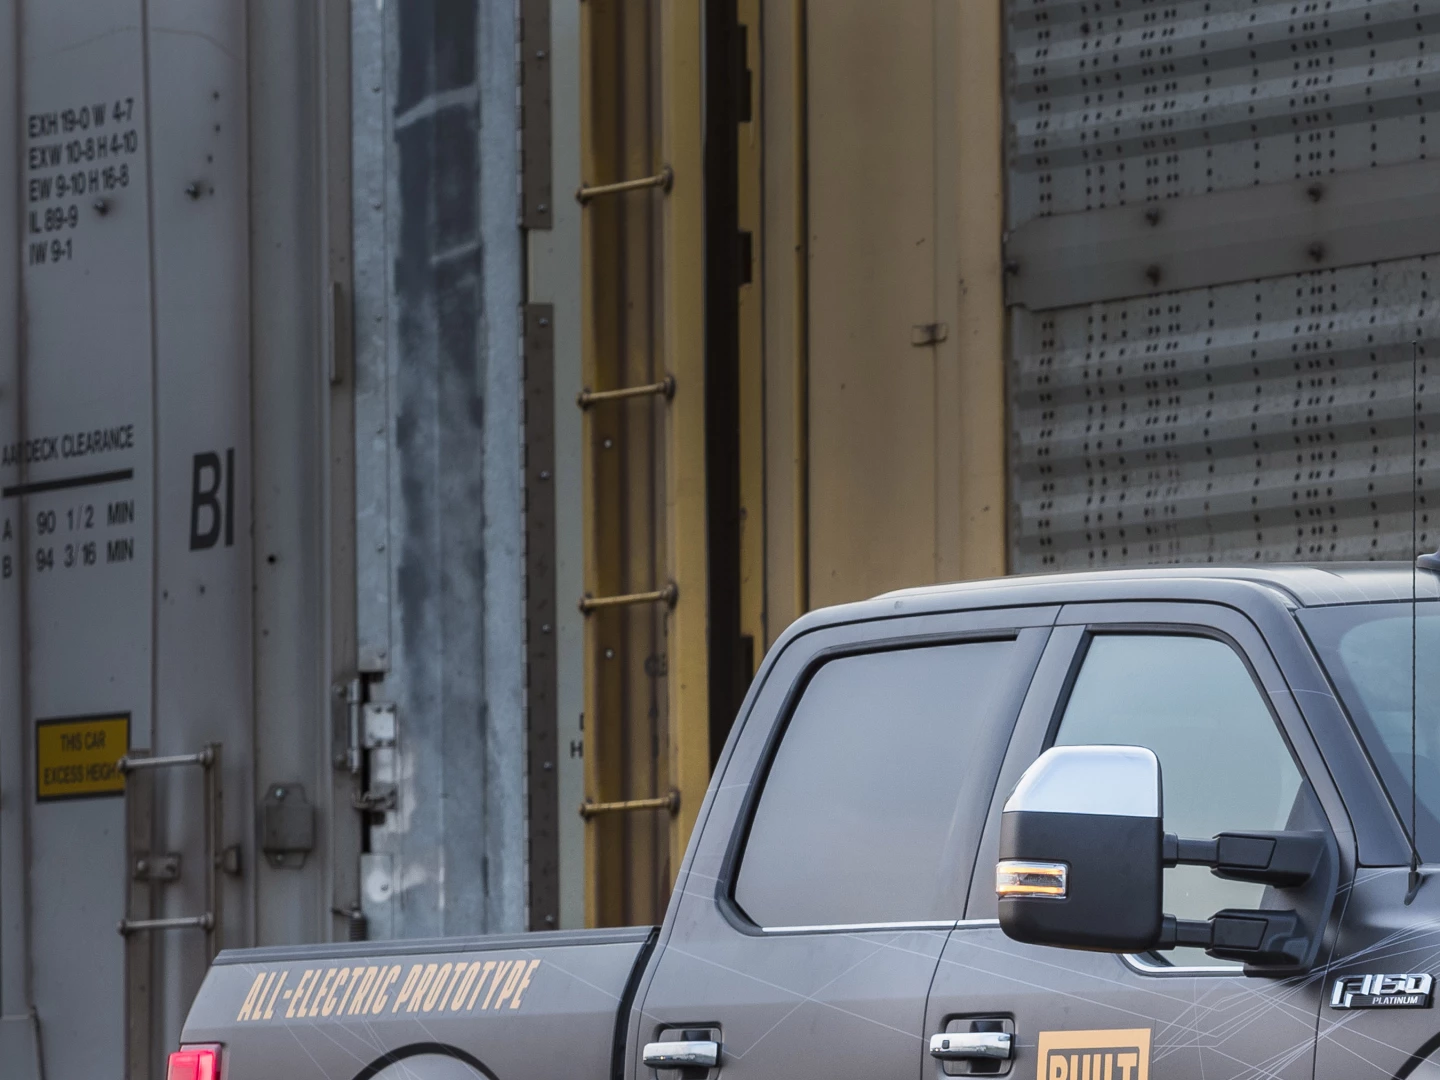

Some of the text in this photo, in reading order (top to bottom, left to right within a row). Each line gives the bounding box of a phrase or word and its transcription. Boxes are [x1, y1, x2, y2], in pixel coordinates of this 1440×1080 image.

[28, 97, 134, 139] EXH 19-0 W 4-7
[28, 129, 138, 170] EXW 10-8 H 4-10
[29, 177, 52, 203] EW
[55, 171, 86, 199] 9-10
[88, 168, 99, 193] H
[29, 210, 41, 234] IL
[29, 237, 72, 266] IW 9-1
[25, 436, 58, 463] DECK
[61, 424, 134, 458] CLEARANCE
[189, 447, 235, 552] BI
[2, 518, 13, 541] A
[36, 510, 56, 536] 90
[107, 500, 134, 526] MIN
[2, 555, 13, 580] B
[36, 548, 54, 572] 94
[106, 537, 134, 564] MIN
[60, 730, 107, 752] THIS CAR
[44, 762, 122, 786] EXCESS HEIGH
[236, 958, 541, 1022] ALL-ELECTRIC PROTOTYPE
[1372, 995, 1418, 1005] PLATINUM
